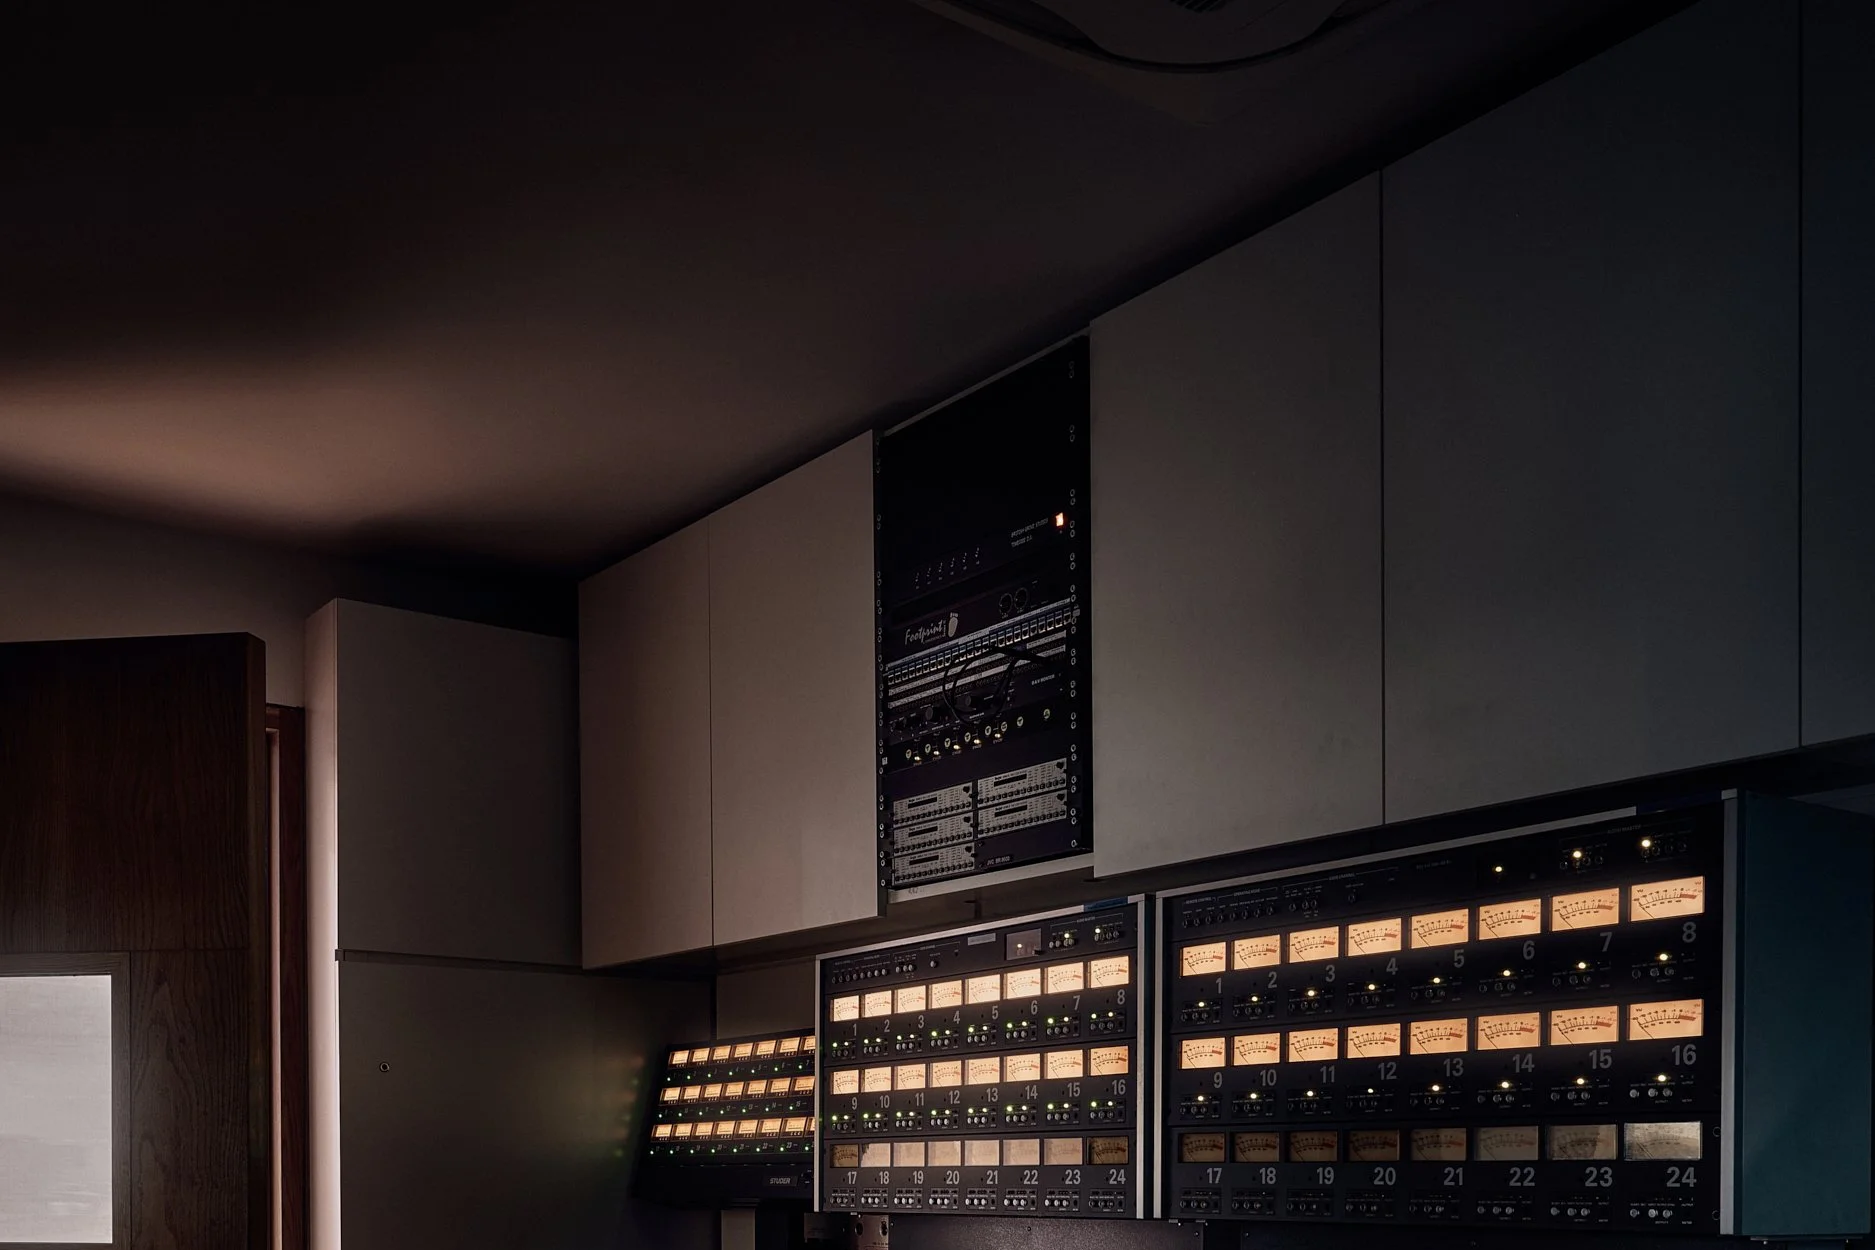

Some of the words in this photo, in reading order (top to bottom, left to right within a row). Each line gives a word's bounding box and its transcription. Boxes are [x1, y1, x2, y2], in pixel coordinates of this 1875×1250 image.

[1682, 922, 1697, 942] 8
[1599, 932, 1613, 951] 7
[1453, 949, 1465, 968] 5
[1522, 941, 1535, 960] 6
[1325, 965, 1335, 982] 3
[1386, 957, 1398, 975] 4
[1216, 978, 1223, 994] 1
[1268, 972, 1277, 988] 2
[1073, 995, 1080, 1010] 7
[1116, 989, 1125, 1004] 8
[991, 1006, 999, 1019] 5
[1030, 1000, 1038, 1014] 6
[918, 1015, 924, 1028] 3
[952, 1011, 960, 1024] 4
[852, 1024, 857, 1036] 1
[884, 1019, 890, 1033] 2
[1589, 1049, 1612, 1069] 15
[1672, 1044, 1696, 1065] 16
[1378, 1062, 1397, 1080] 12
[1443, 1058, 1464, 1076] 13
[1512, 1053, 1535, 1073] 14
[1213, 1072, 1223, 1088] 9
[1259, 1069, 1277, 1086] 10
[1320, 1065, 1336, 1083] 11
[985, 1088, 998, 1102] 13
[1025, 1085, 1038, 1100] 14
[1066, 1082, 1081, 1097] 15
[1111, 1079, 1126, 1095] 16
[851, 1097, 857, 1110] 9
[879, 1095, 890, 1108] 10
[915, 1093, 925, 1106] 11
[948, 1090, 960, 1104] 12
[769, 1177, 791, 1185] STUDER
[846, 1172, 857, 1184] 17
[878, 1171, 890, 1184] 18
[912, 1171, 924, 1184] 19
[946, 1171, 959, 1184] 20
[986, 1170, 999, 1184] 21
[1023, 1170, 1038, 1184] 22
[1065, 1169, 1081, 1184] 23
[1108, 1169, 1126, 1185] 24
[1206, 1167, 1222, 1184] 17
[1259, 1167, 1276, 1184] 18
[1316, 1167, 1334, 1184] 19
[1373, 1167, 1396, 1185] 20
[1443, 1167, 1464, 1186] 21
[1509, 1167, 1536, 1186] 22
[1585, 1167, 1613, 1187] 23
[1666, 1167, 1696, 1187] 24
